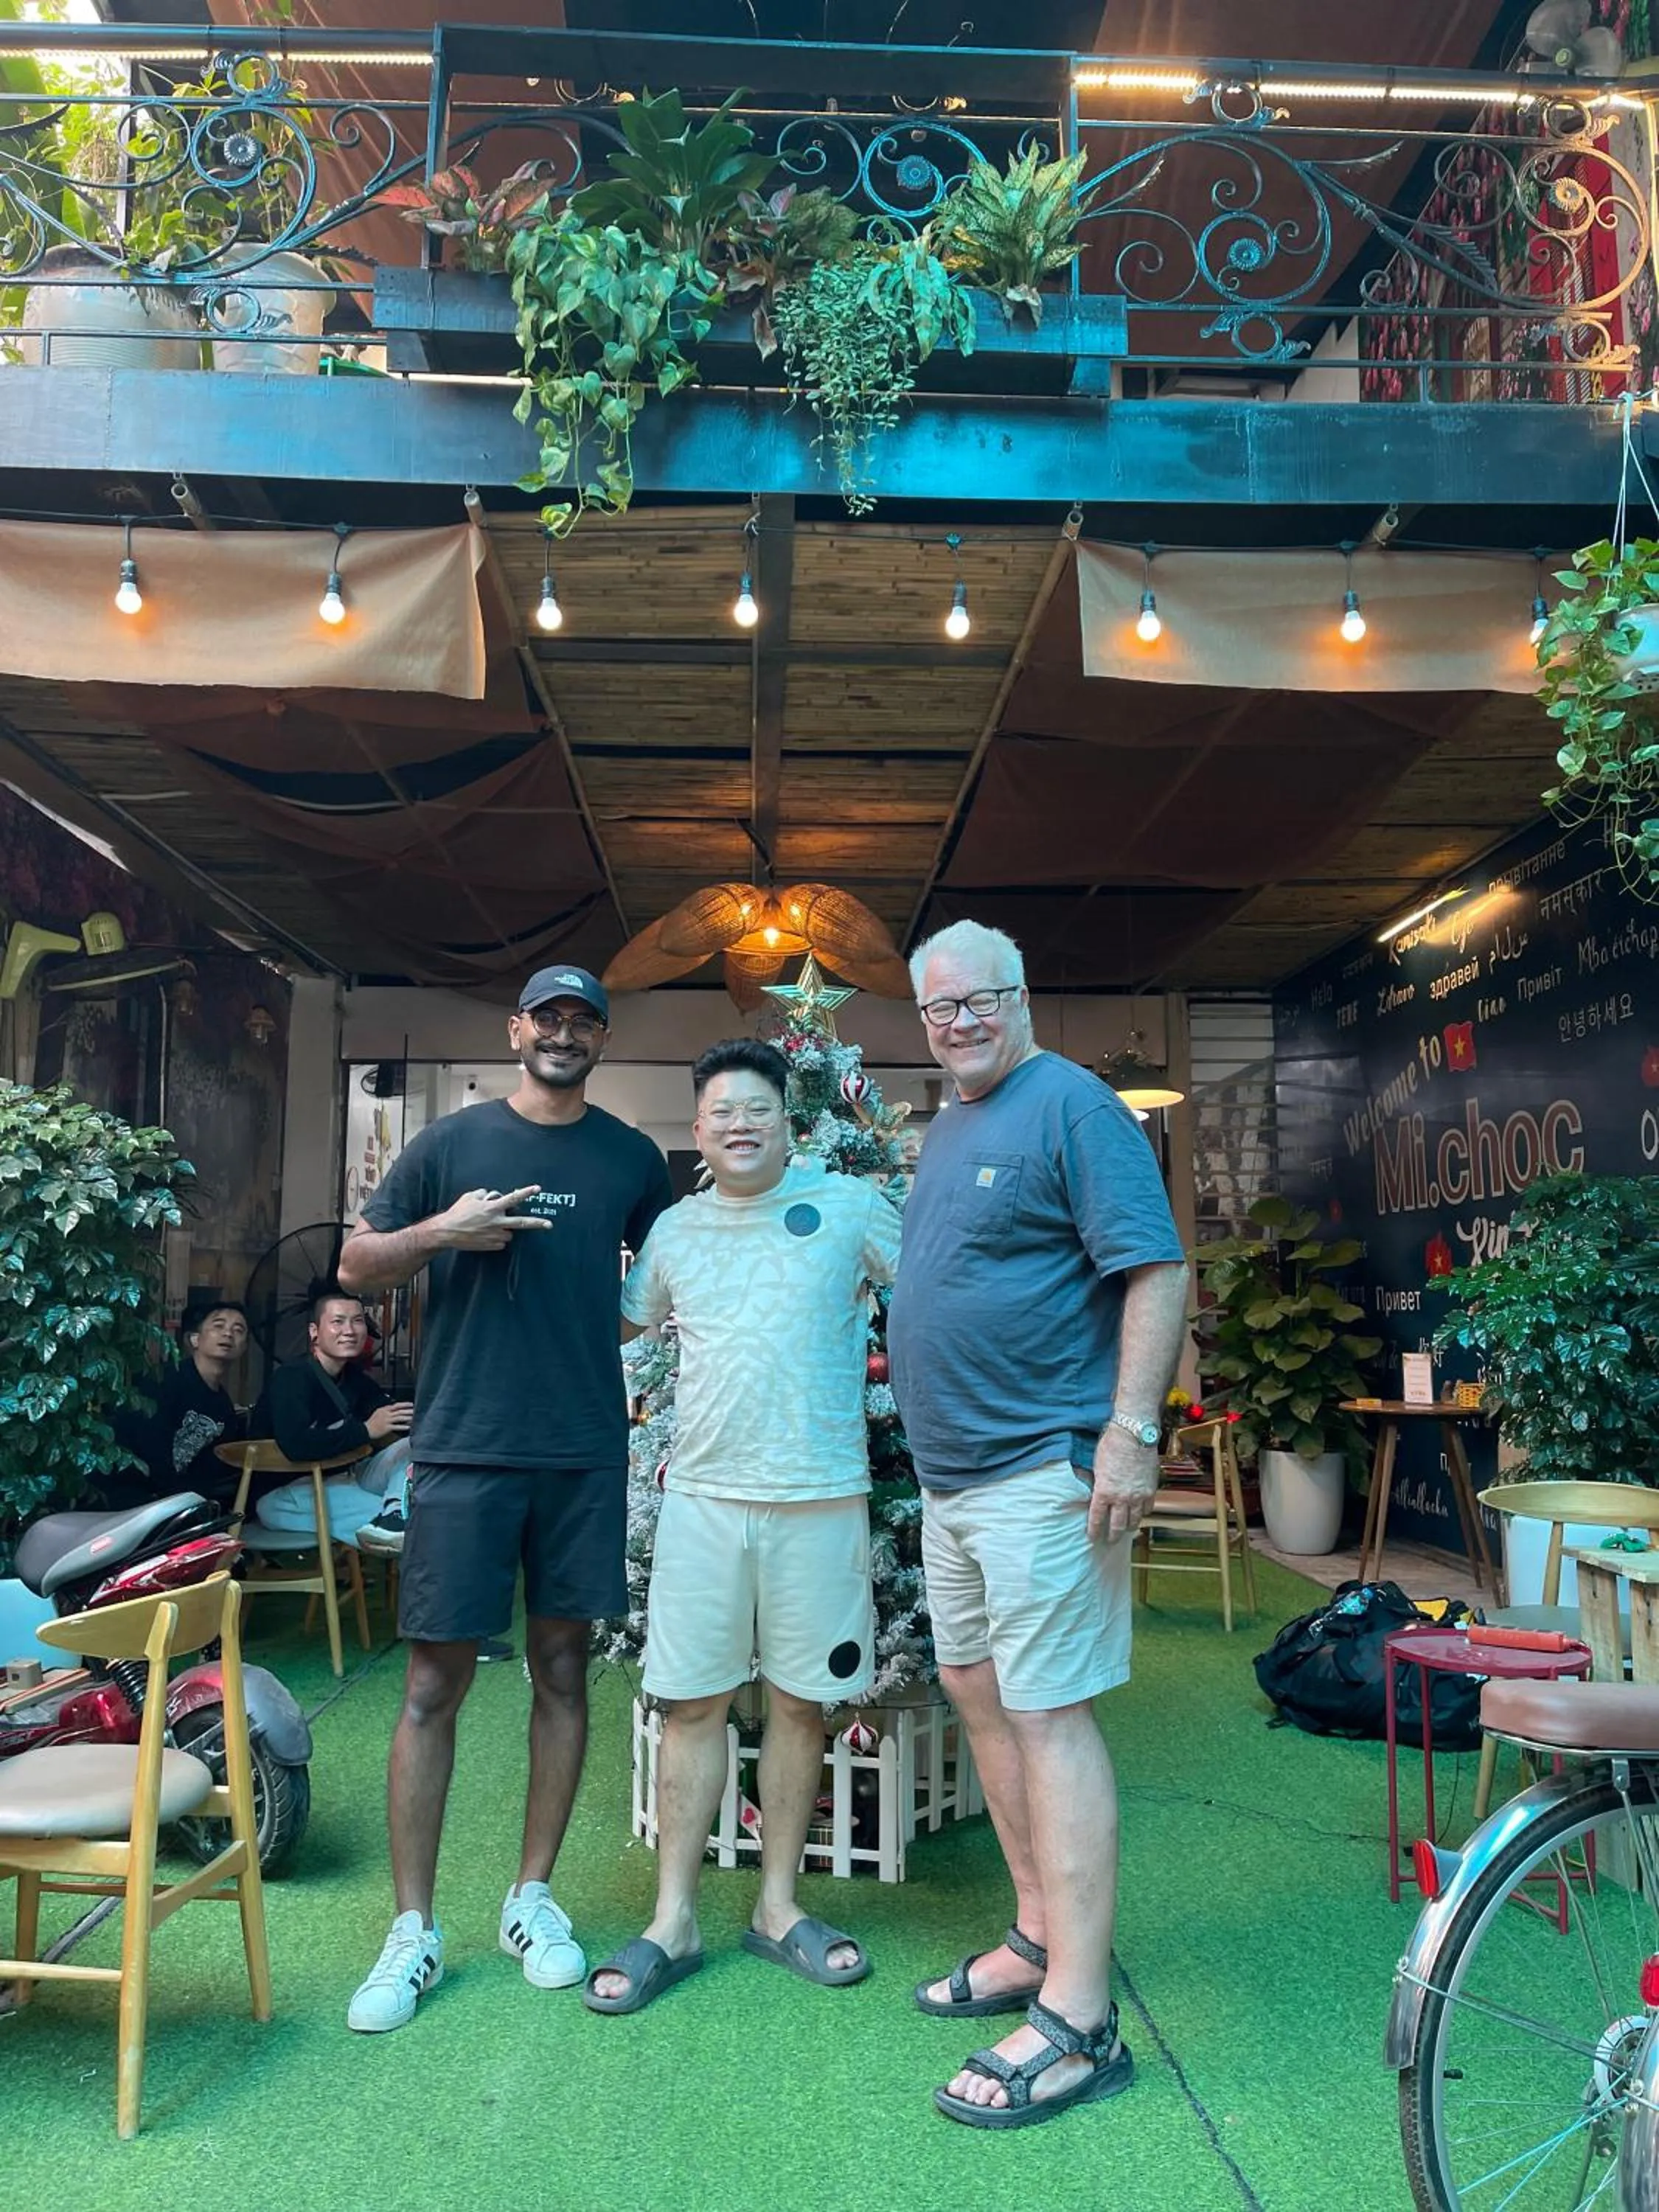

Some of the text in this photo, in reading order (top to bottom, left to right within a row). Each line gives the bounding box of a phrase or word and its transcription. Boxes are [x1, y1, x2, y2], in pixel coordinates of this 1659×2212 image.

[1429, 955, 1480, 1001] здравей
[1557, 992, 1634, 1043] 안녕하세요
[1343, 1034, 1441, 1157] Welcome to
[1373, 1098, 1586, 1215] Mi.choc
[1376, 1285, 1422, 1318] Привет
